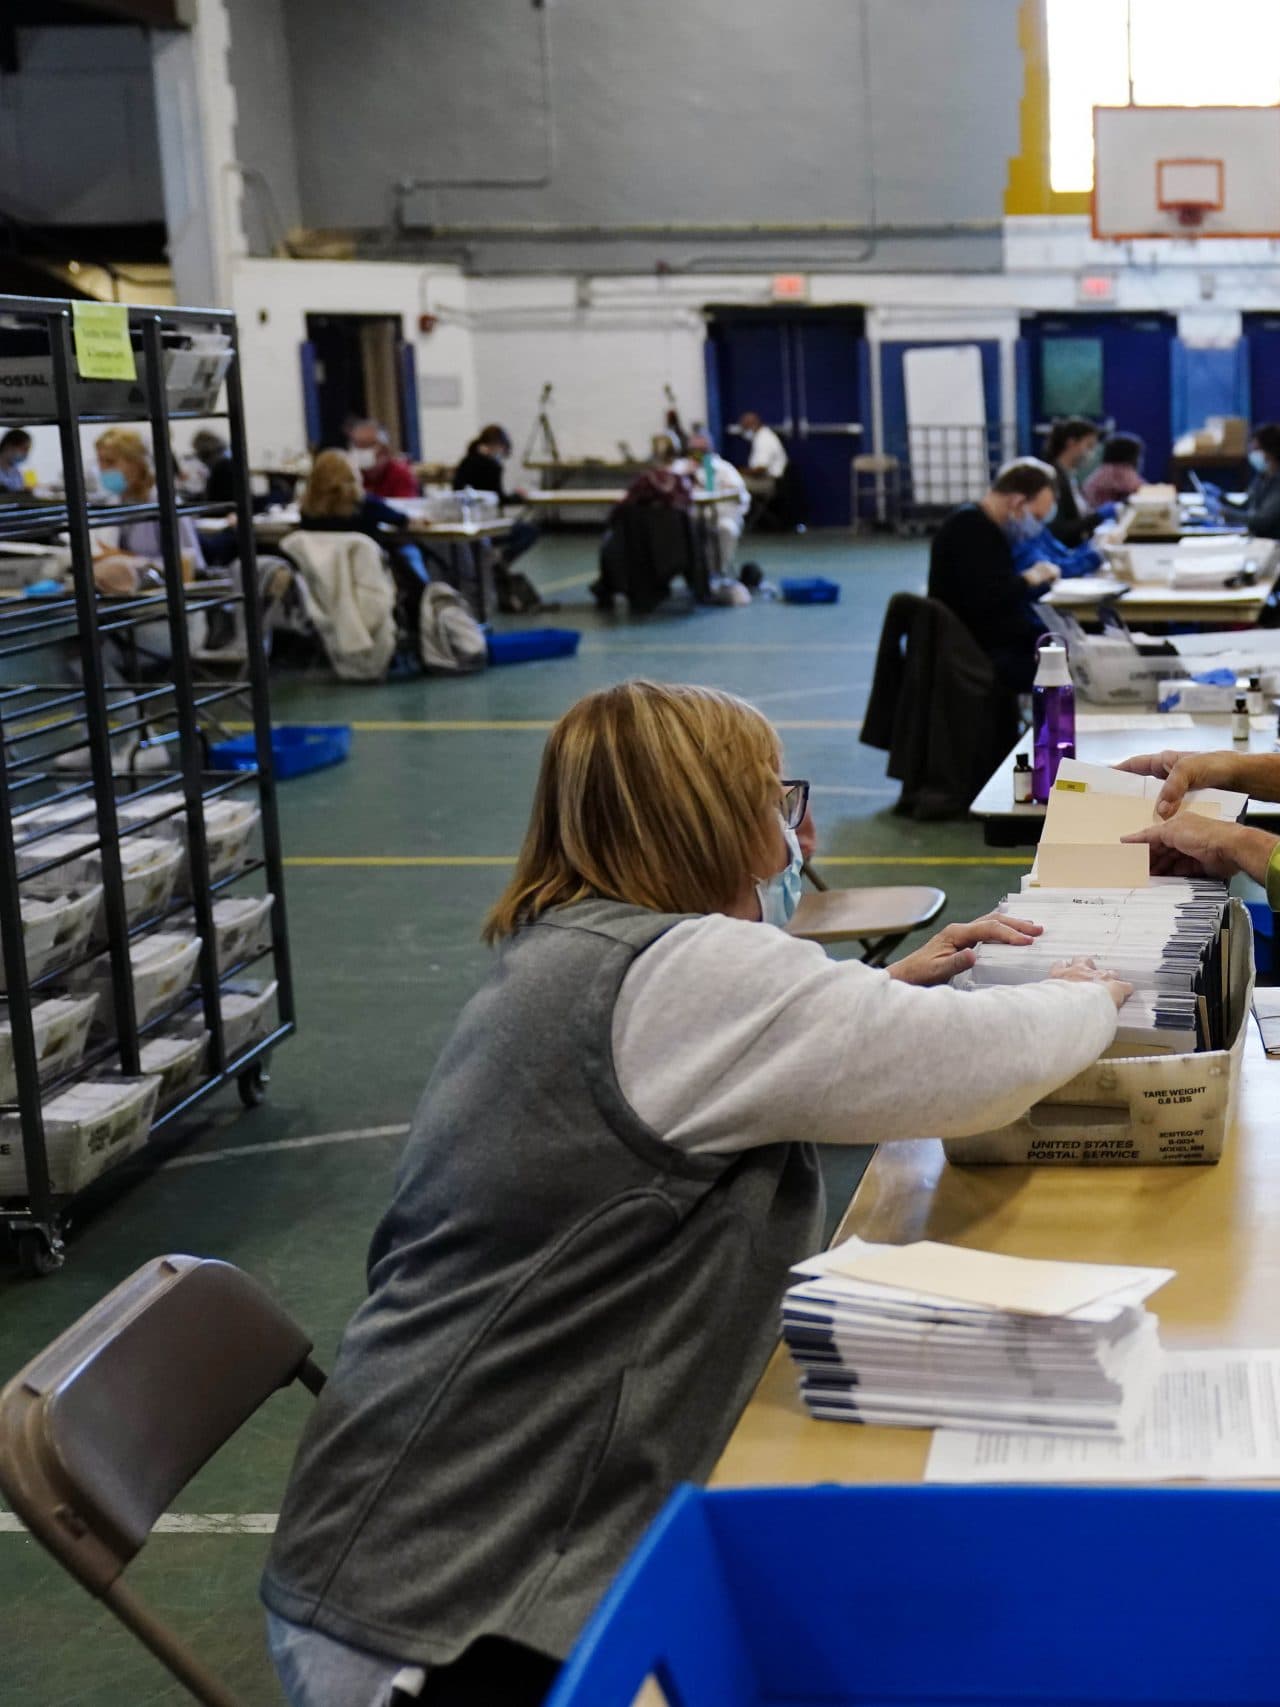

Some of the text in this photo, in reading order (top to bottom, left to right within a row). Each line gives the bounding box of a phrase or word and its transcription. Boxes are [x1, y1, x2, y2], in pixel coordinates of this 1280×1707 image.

[1169, 1087, 1207, 1096] WEIGHT
[1173, 1096, 1192, 1104] LBS
[1031, 1140, 1134, 1149] UNITED STATES
[1027, 1150, 1140, 1160] POSTAL SERVICE
